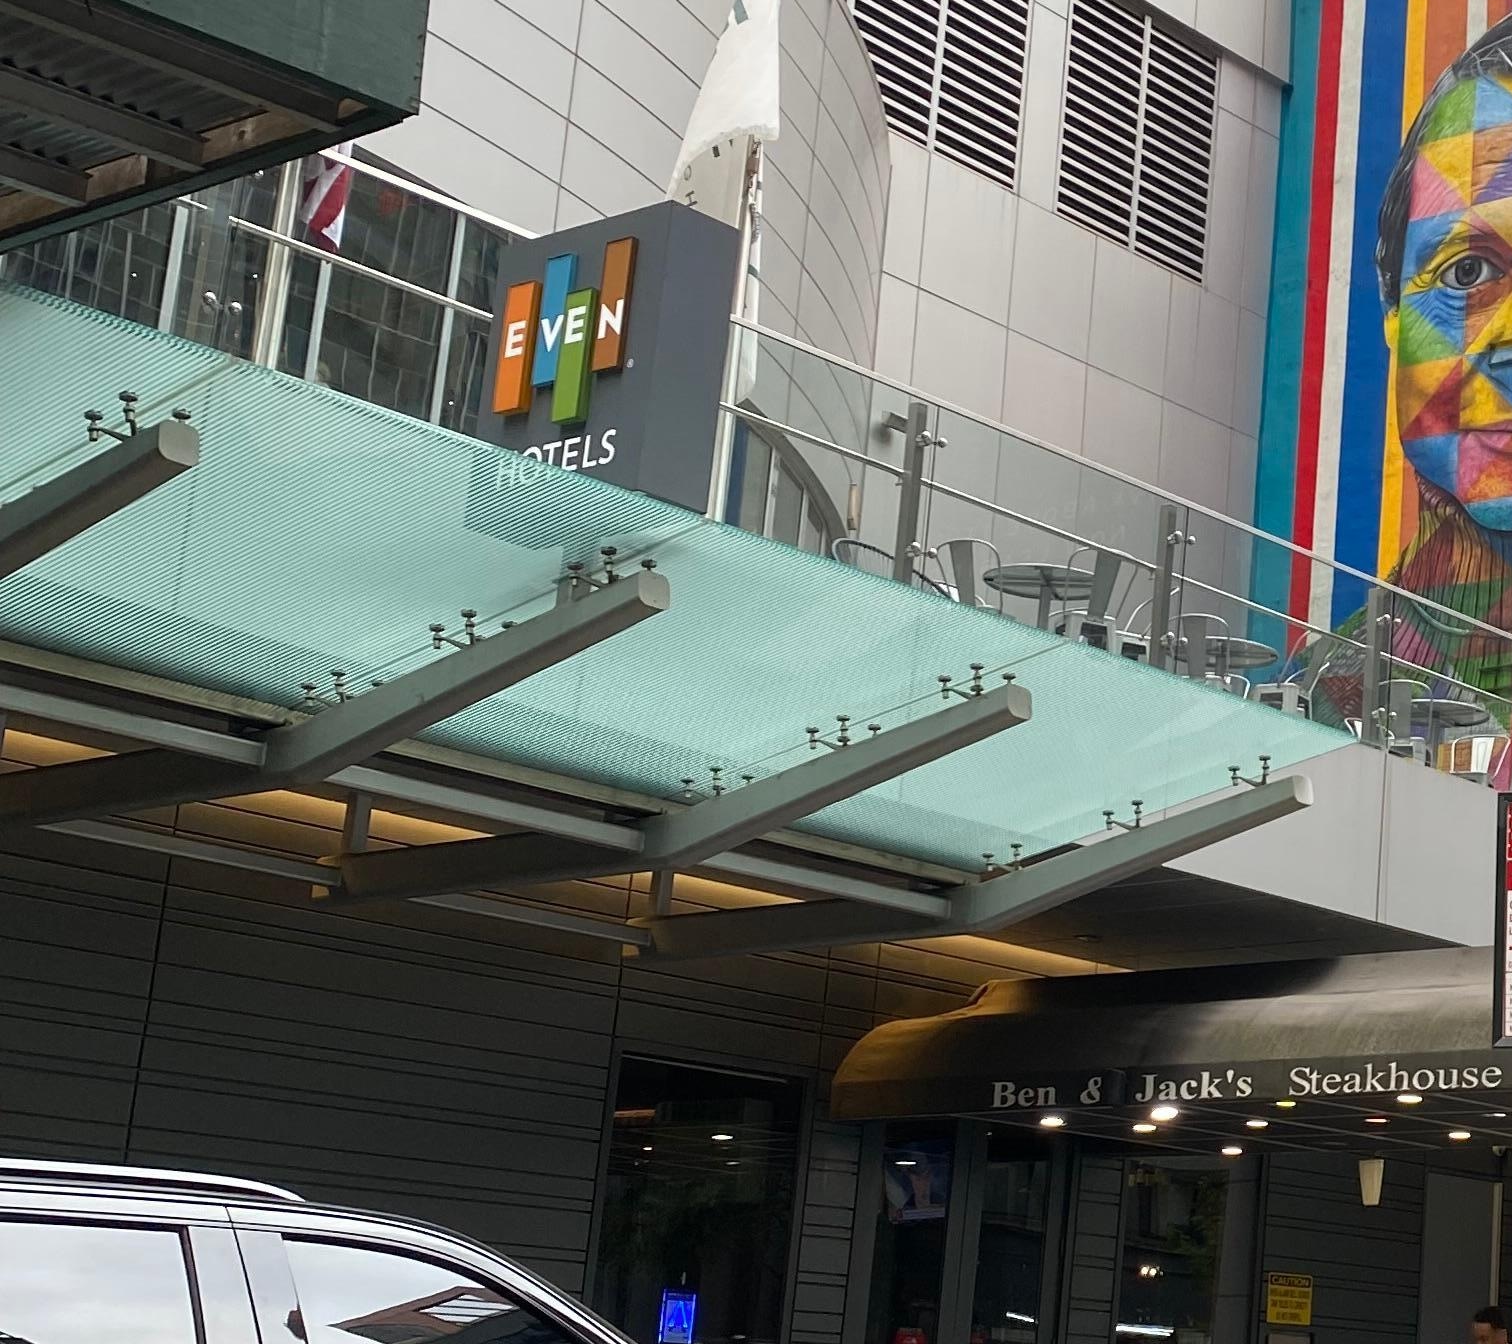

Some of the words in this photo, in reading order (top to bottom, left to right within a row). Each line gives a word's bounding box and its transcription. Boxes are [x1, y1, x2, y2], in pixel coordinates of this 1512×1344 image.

[504, 298, 625, 358] EVEN
[991, 1081, 1057, 1108] Ben
[1080, 1076, 1102, 1105] &
[1135, 1069, 1253, 1102] Jack's
[1289, 1061, 1503, 1097] Steakhouse
[1271, 1275, 1310, 1288] CAUTION
